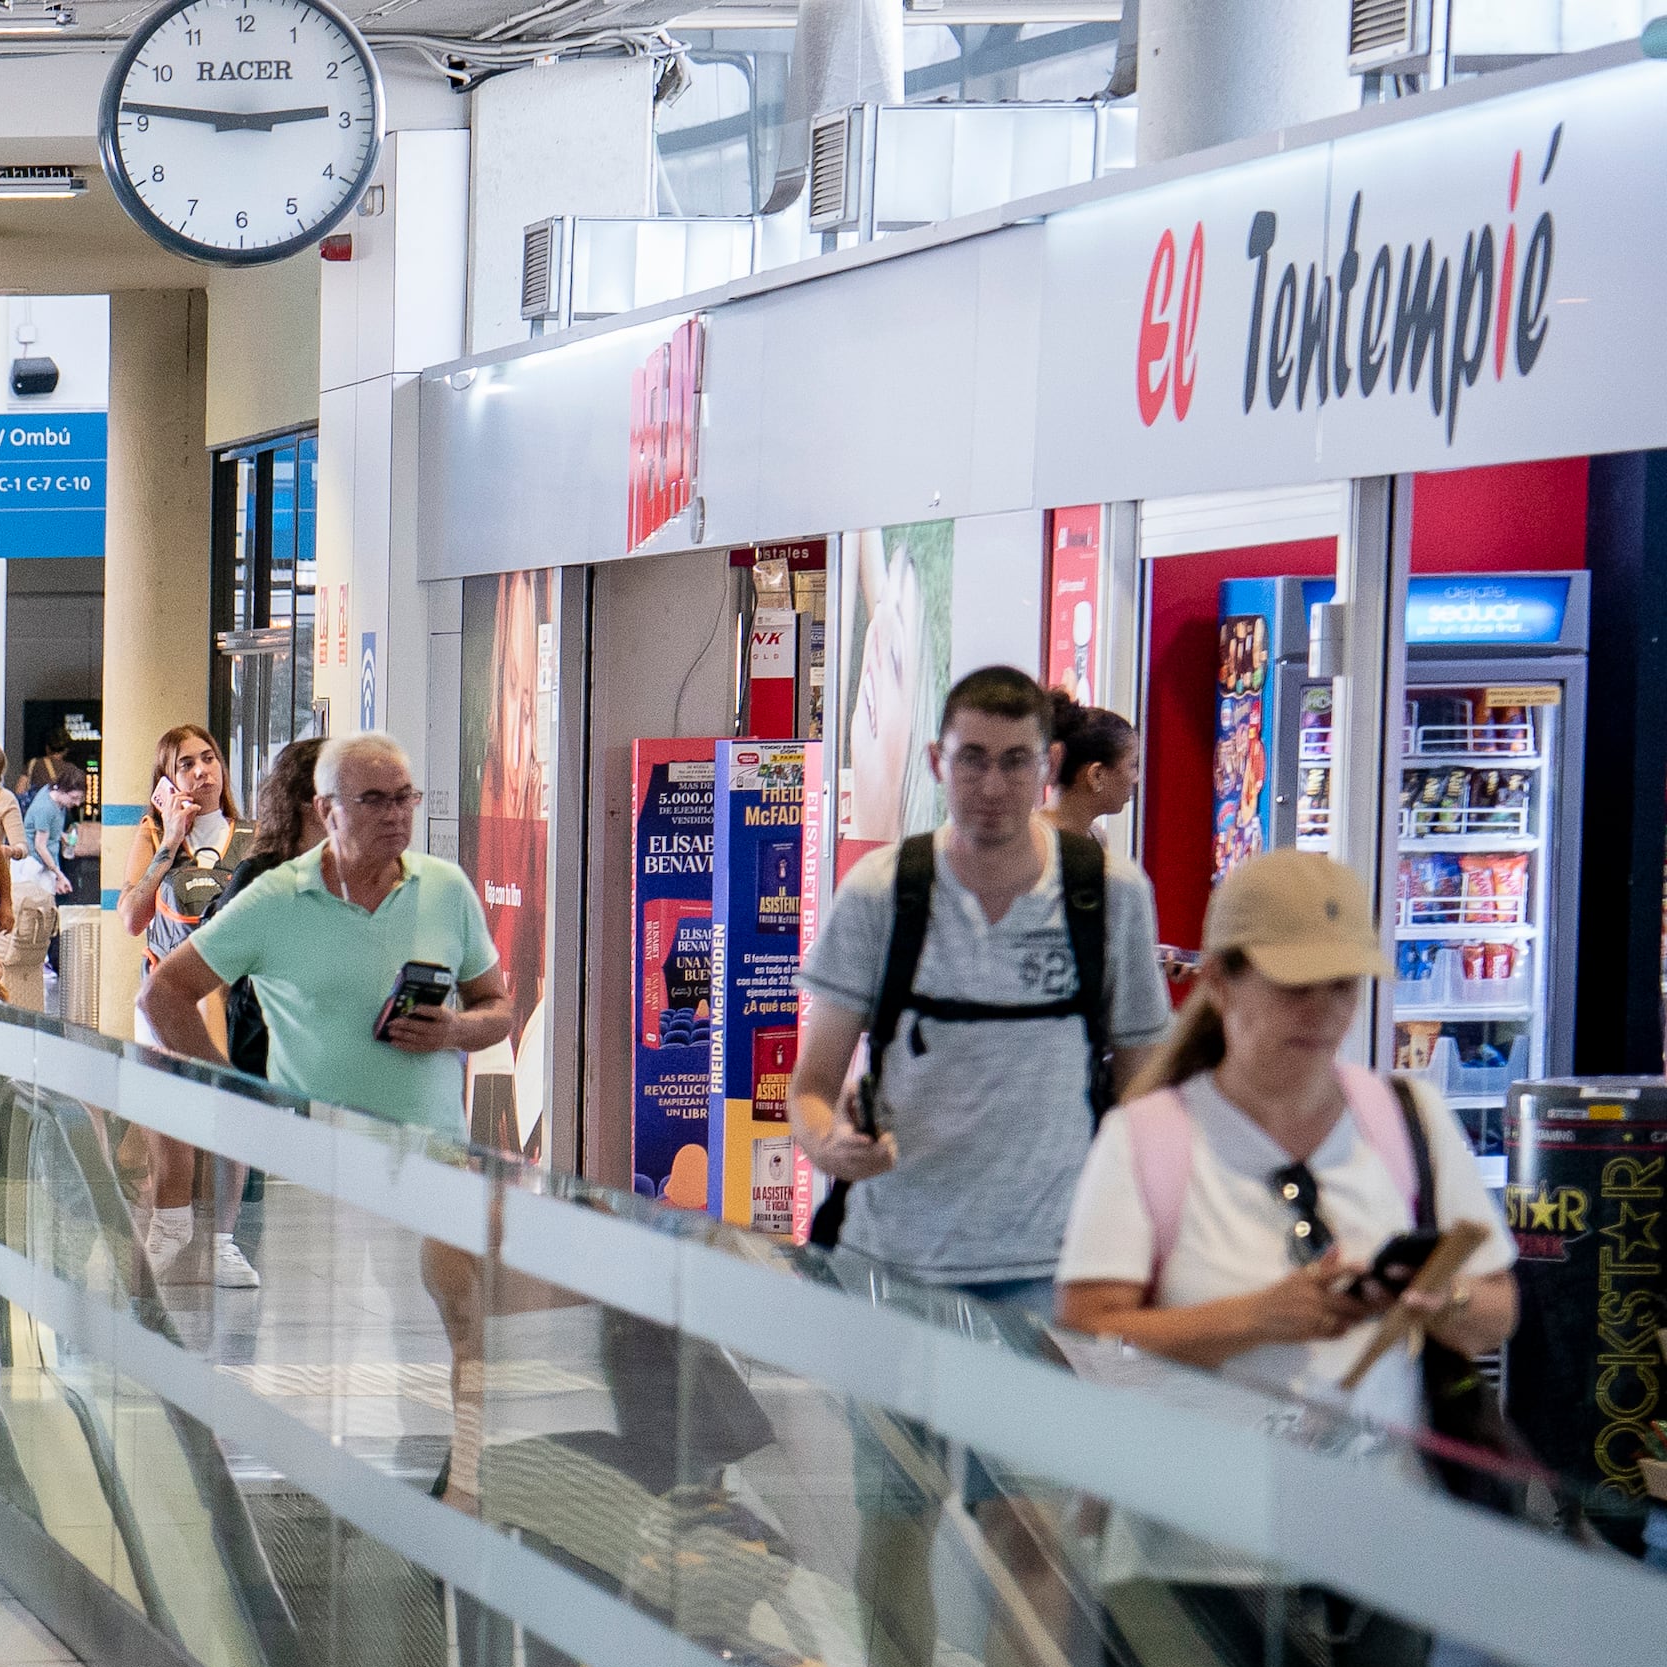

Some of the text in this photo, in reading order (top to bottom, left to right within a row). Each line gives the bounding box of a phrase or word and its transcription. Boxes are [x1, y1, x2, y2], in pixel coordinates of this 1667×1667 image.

[235, 15, 256, 33] 12
[185, 29, 202, 46] 11
[290, 28, 297, 44] 1
[152, 65, 173, 82] 10
[196, 60, 293, 82] RACER
[326, 63, 339, 80] 2
[137, 115, 149, 132] 9
[339, 111, 351, 129] 3
[152, 165, 165, 182] 8
[322, 163, 335, 180] 4
[187, 199, 199, 216] 7
[286, 198, 298, 215] 5
[236, 211, 248, 228] 6
[1242, 121, 1564, 446] Tentempié
[10, 427, 71, 446] Ombú
[26, 476, 52, 492] C-7
[55, 475, 91, 492] C-10
[1428, 600, 1522, 623] seducir
[699, 782, 713, 790] DE
[659, 806, 672, 815] DE
[671, 816, 714, 825] VENDIDO
[803, 791, 819, 904] ELÍSABET
[676, 957, 701, 968] UNA
[711, 924, 726, 1094] FREIDA McFADDEN
[759, 999, 778, 1014] qué
[660, 1074, 676, 1082] LAS
[667, 1108, 709, 1119] UN LIBR
[794, 1171, 809, 1246] BUENA
